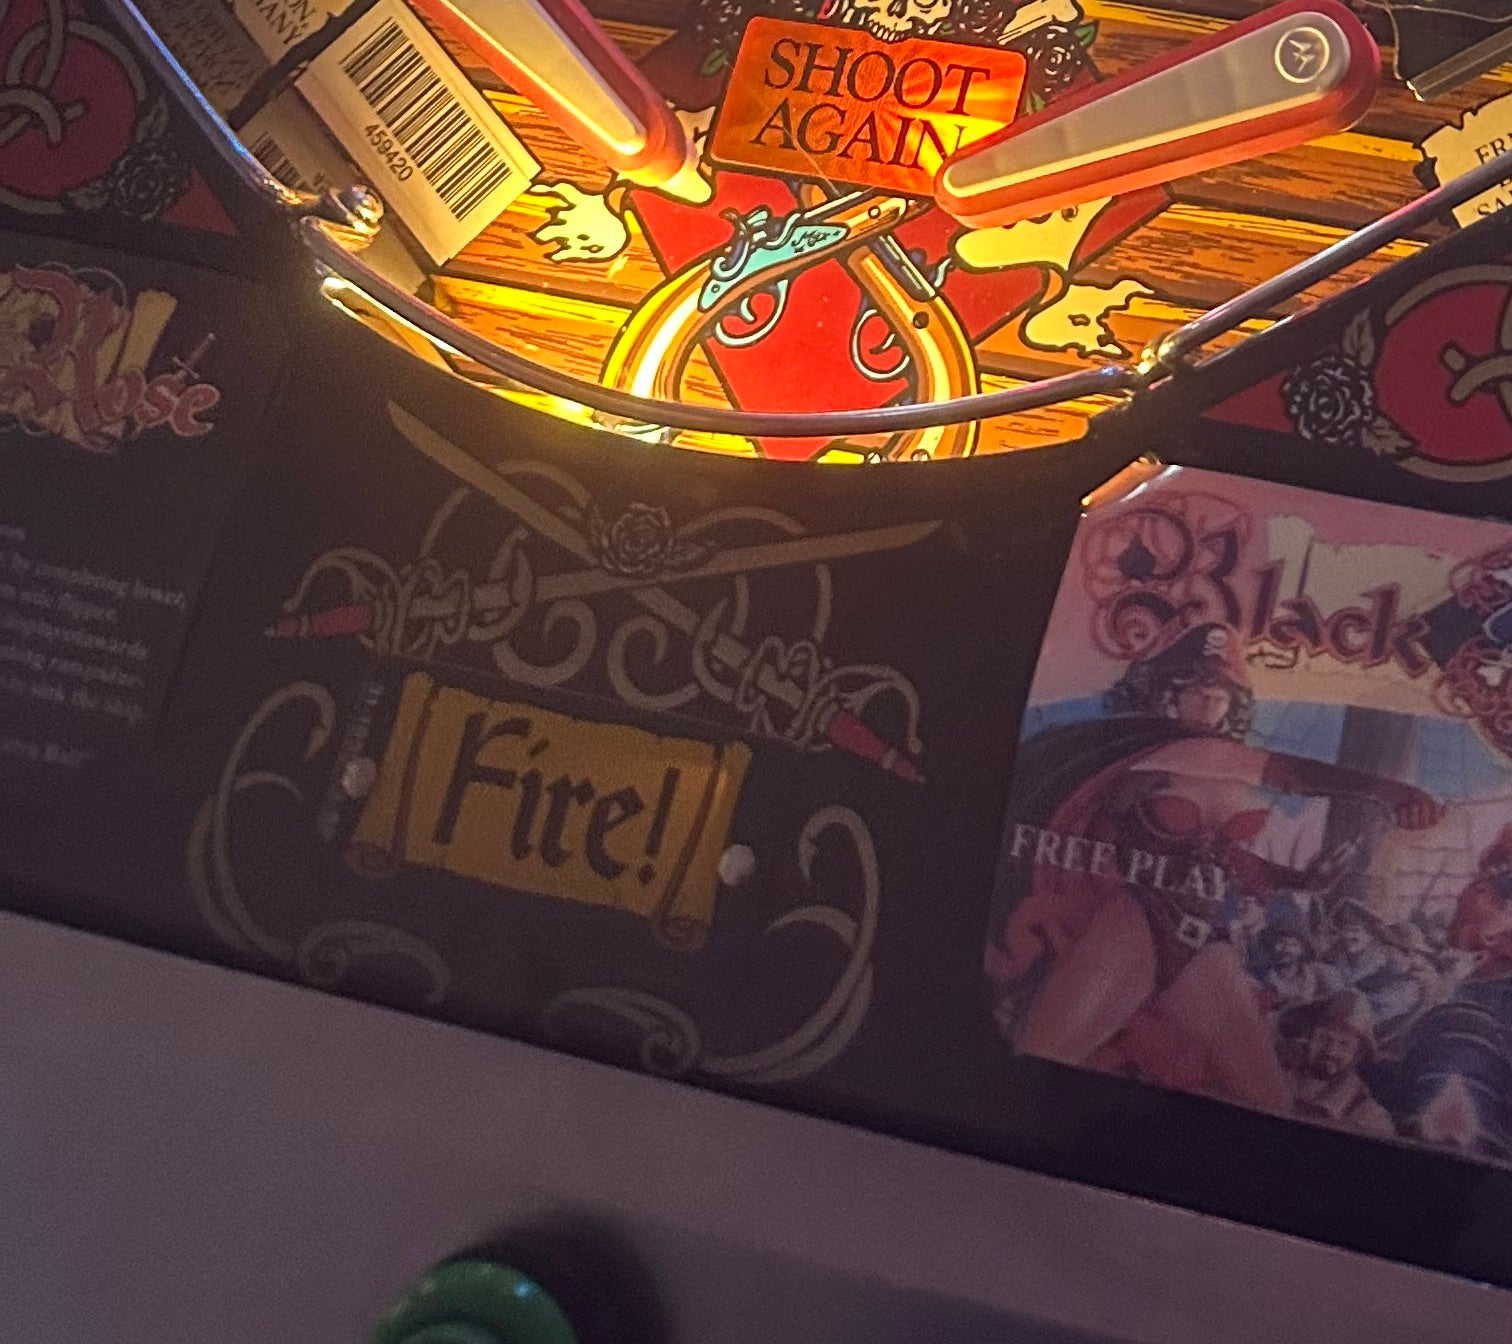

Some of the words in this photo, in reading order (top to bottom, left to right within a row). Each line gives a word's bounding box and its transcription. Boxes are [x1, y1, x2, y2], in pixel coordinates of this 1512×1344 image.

[764, 37, 991, 117] SHOOT
[364, 123, 414, 182] 459420
[749, 96, 969, 171] AGAIN
[1081, 492, 1437, 679] Black
[431, 711, 681, 885] Fire!
[1010, 822, 1117, 876] FREE
[1125, 847, 1228, 904] PLAY
